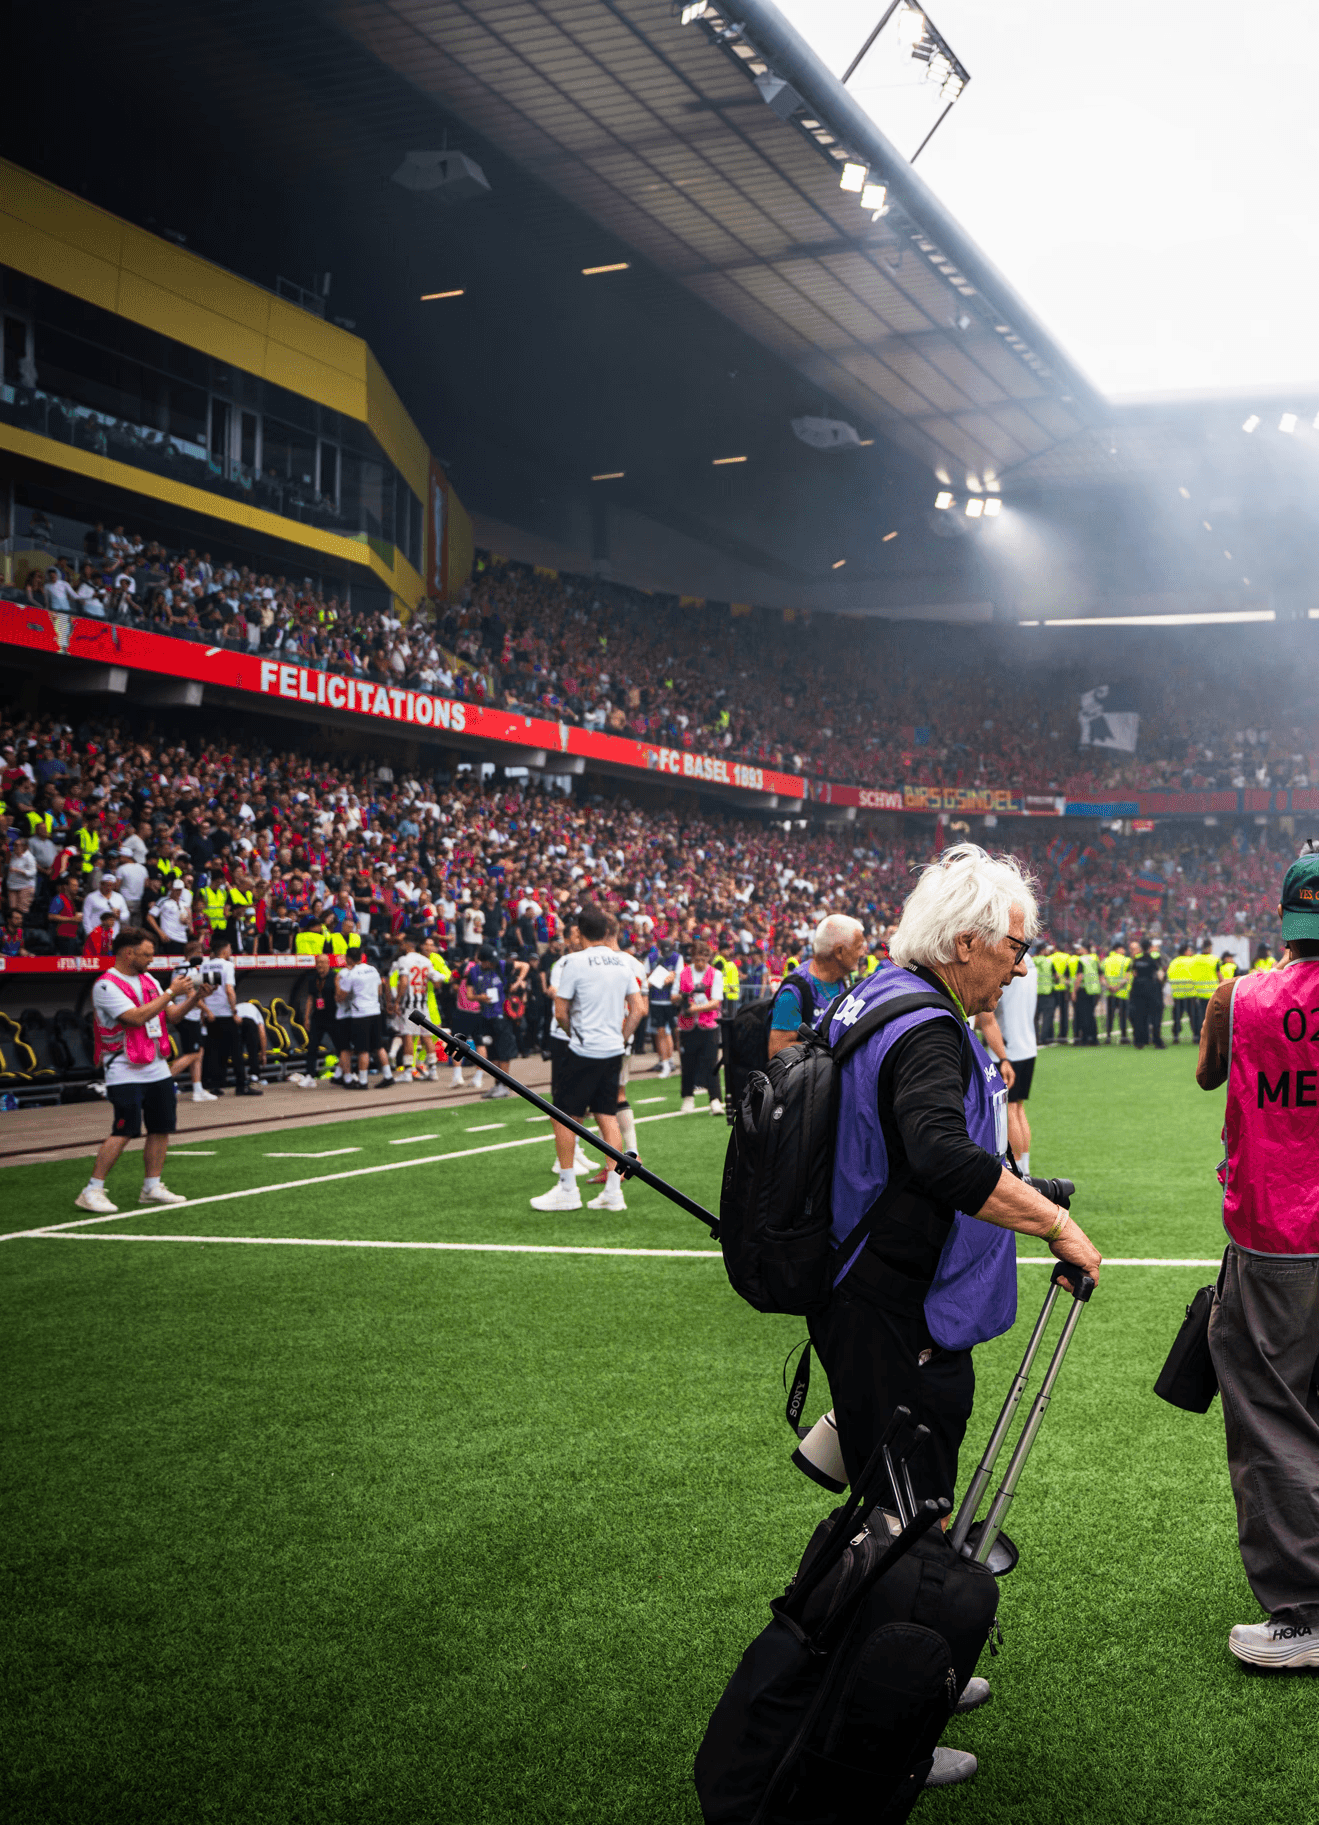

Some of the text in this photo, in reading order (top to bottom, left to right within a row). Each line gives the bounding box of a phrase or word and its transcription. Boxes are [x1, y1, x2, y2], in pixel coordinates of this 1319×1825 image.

[260, 661, 466, 731] FELICITATIONS
[659, 747, 680, 774] FC
[683, 751, 730, 784] BASEL
[790, 1381, 805, 1418] SONY
[1273, 1626, 1312, 1640] HOKA
